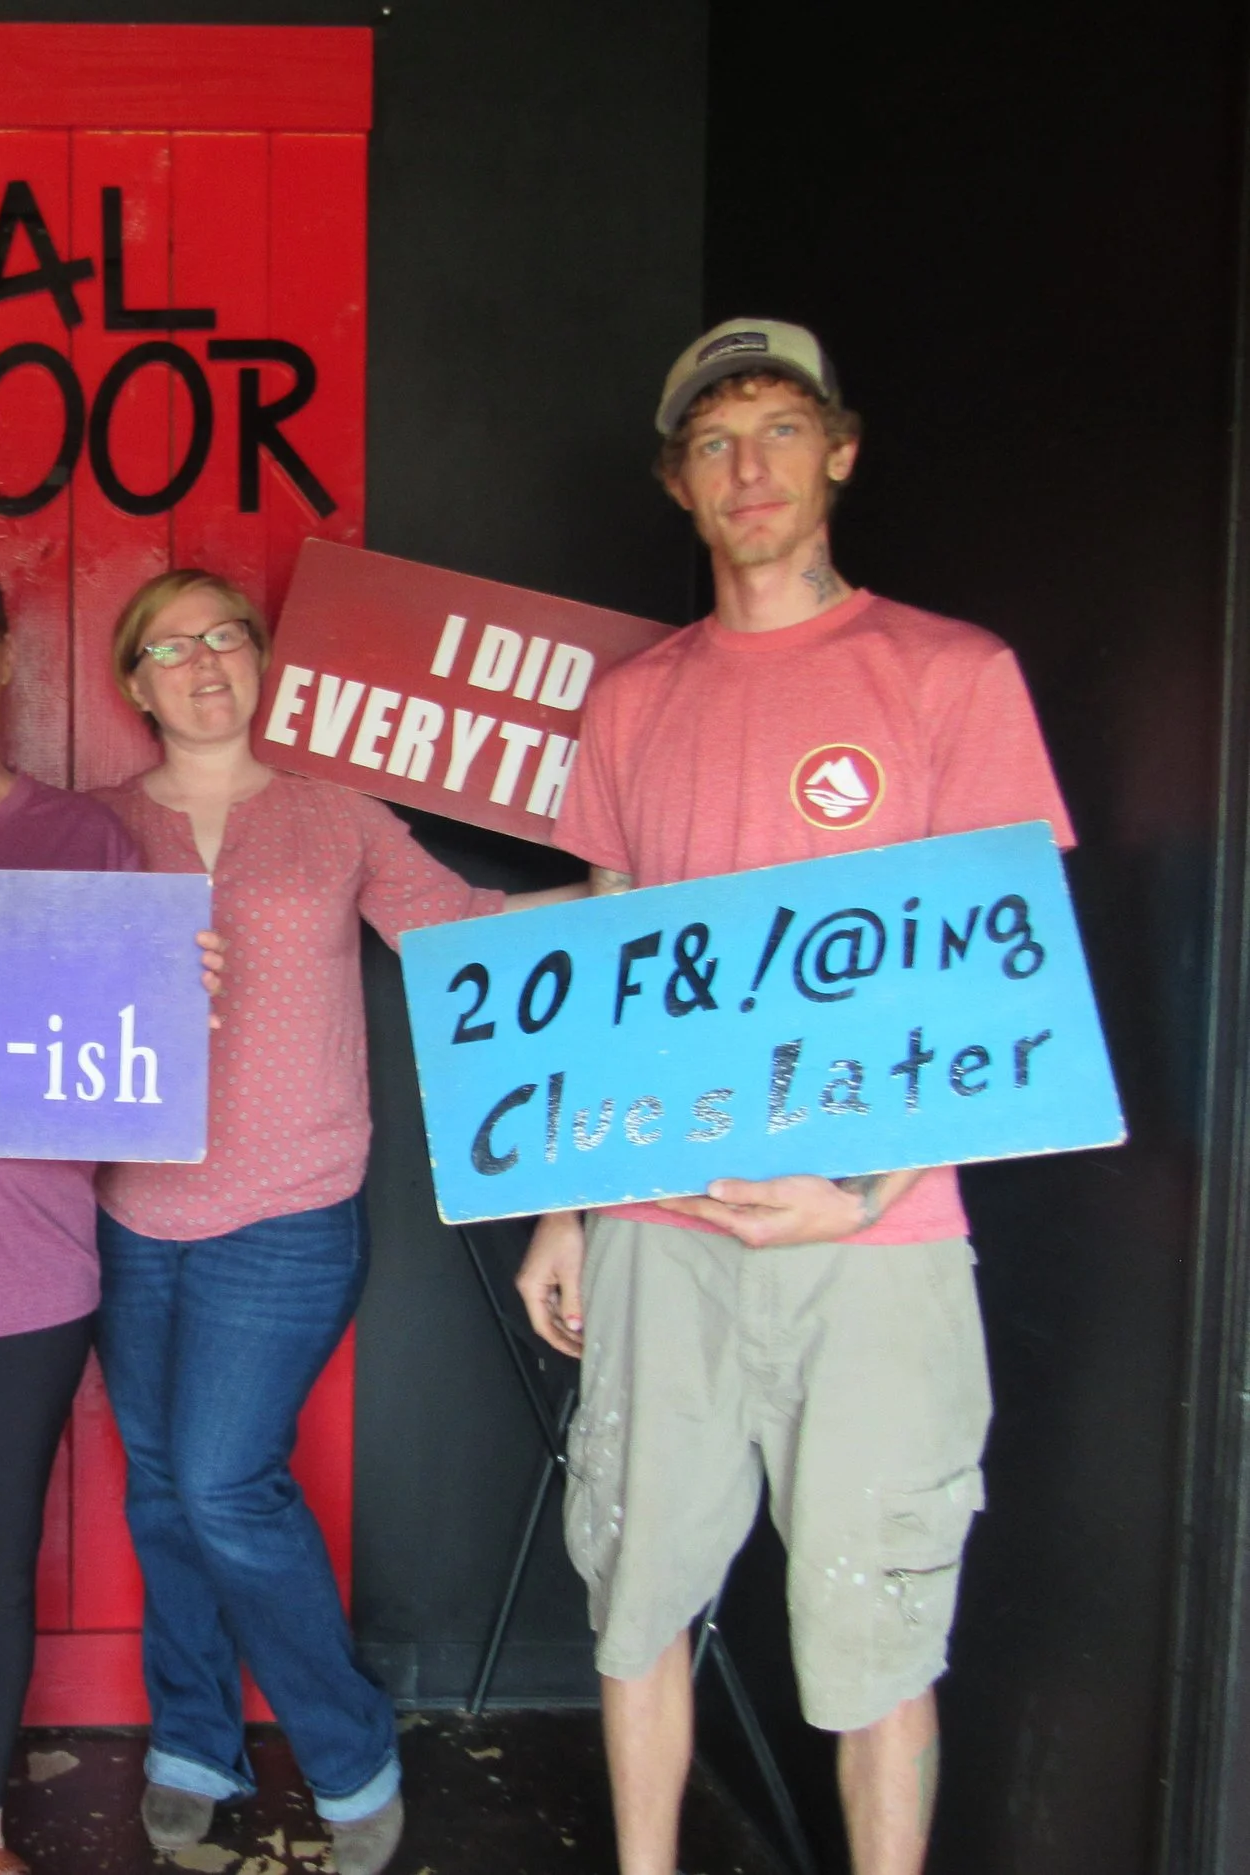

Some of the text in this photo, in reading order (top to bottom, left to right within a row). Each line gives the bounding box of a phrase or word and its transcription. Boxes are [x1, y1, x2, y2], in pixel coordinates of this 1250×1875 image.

[430, 614, 595, 711] I DID
[446, 950, 572, 1046] 20
[470, 1026, 1052, 1177] Clues Later
